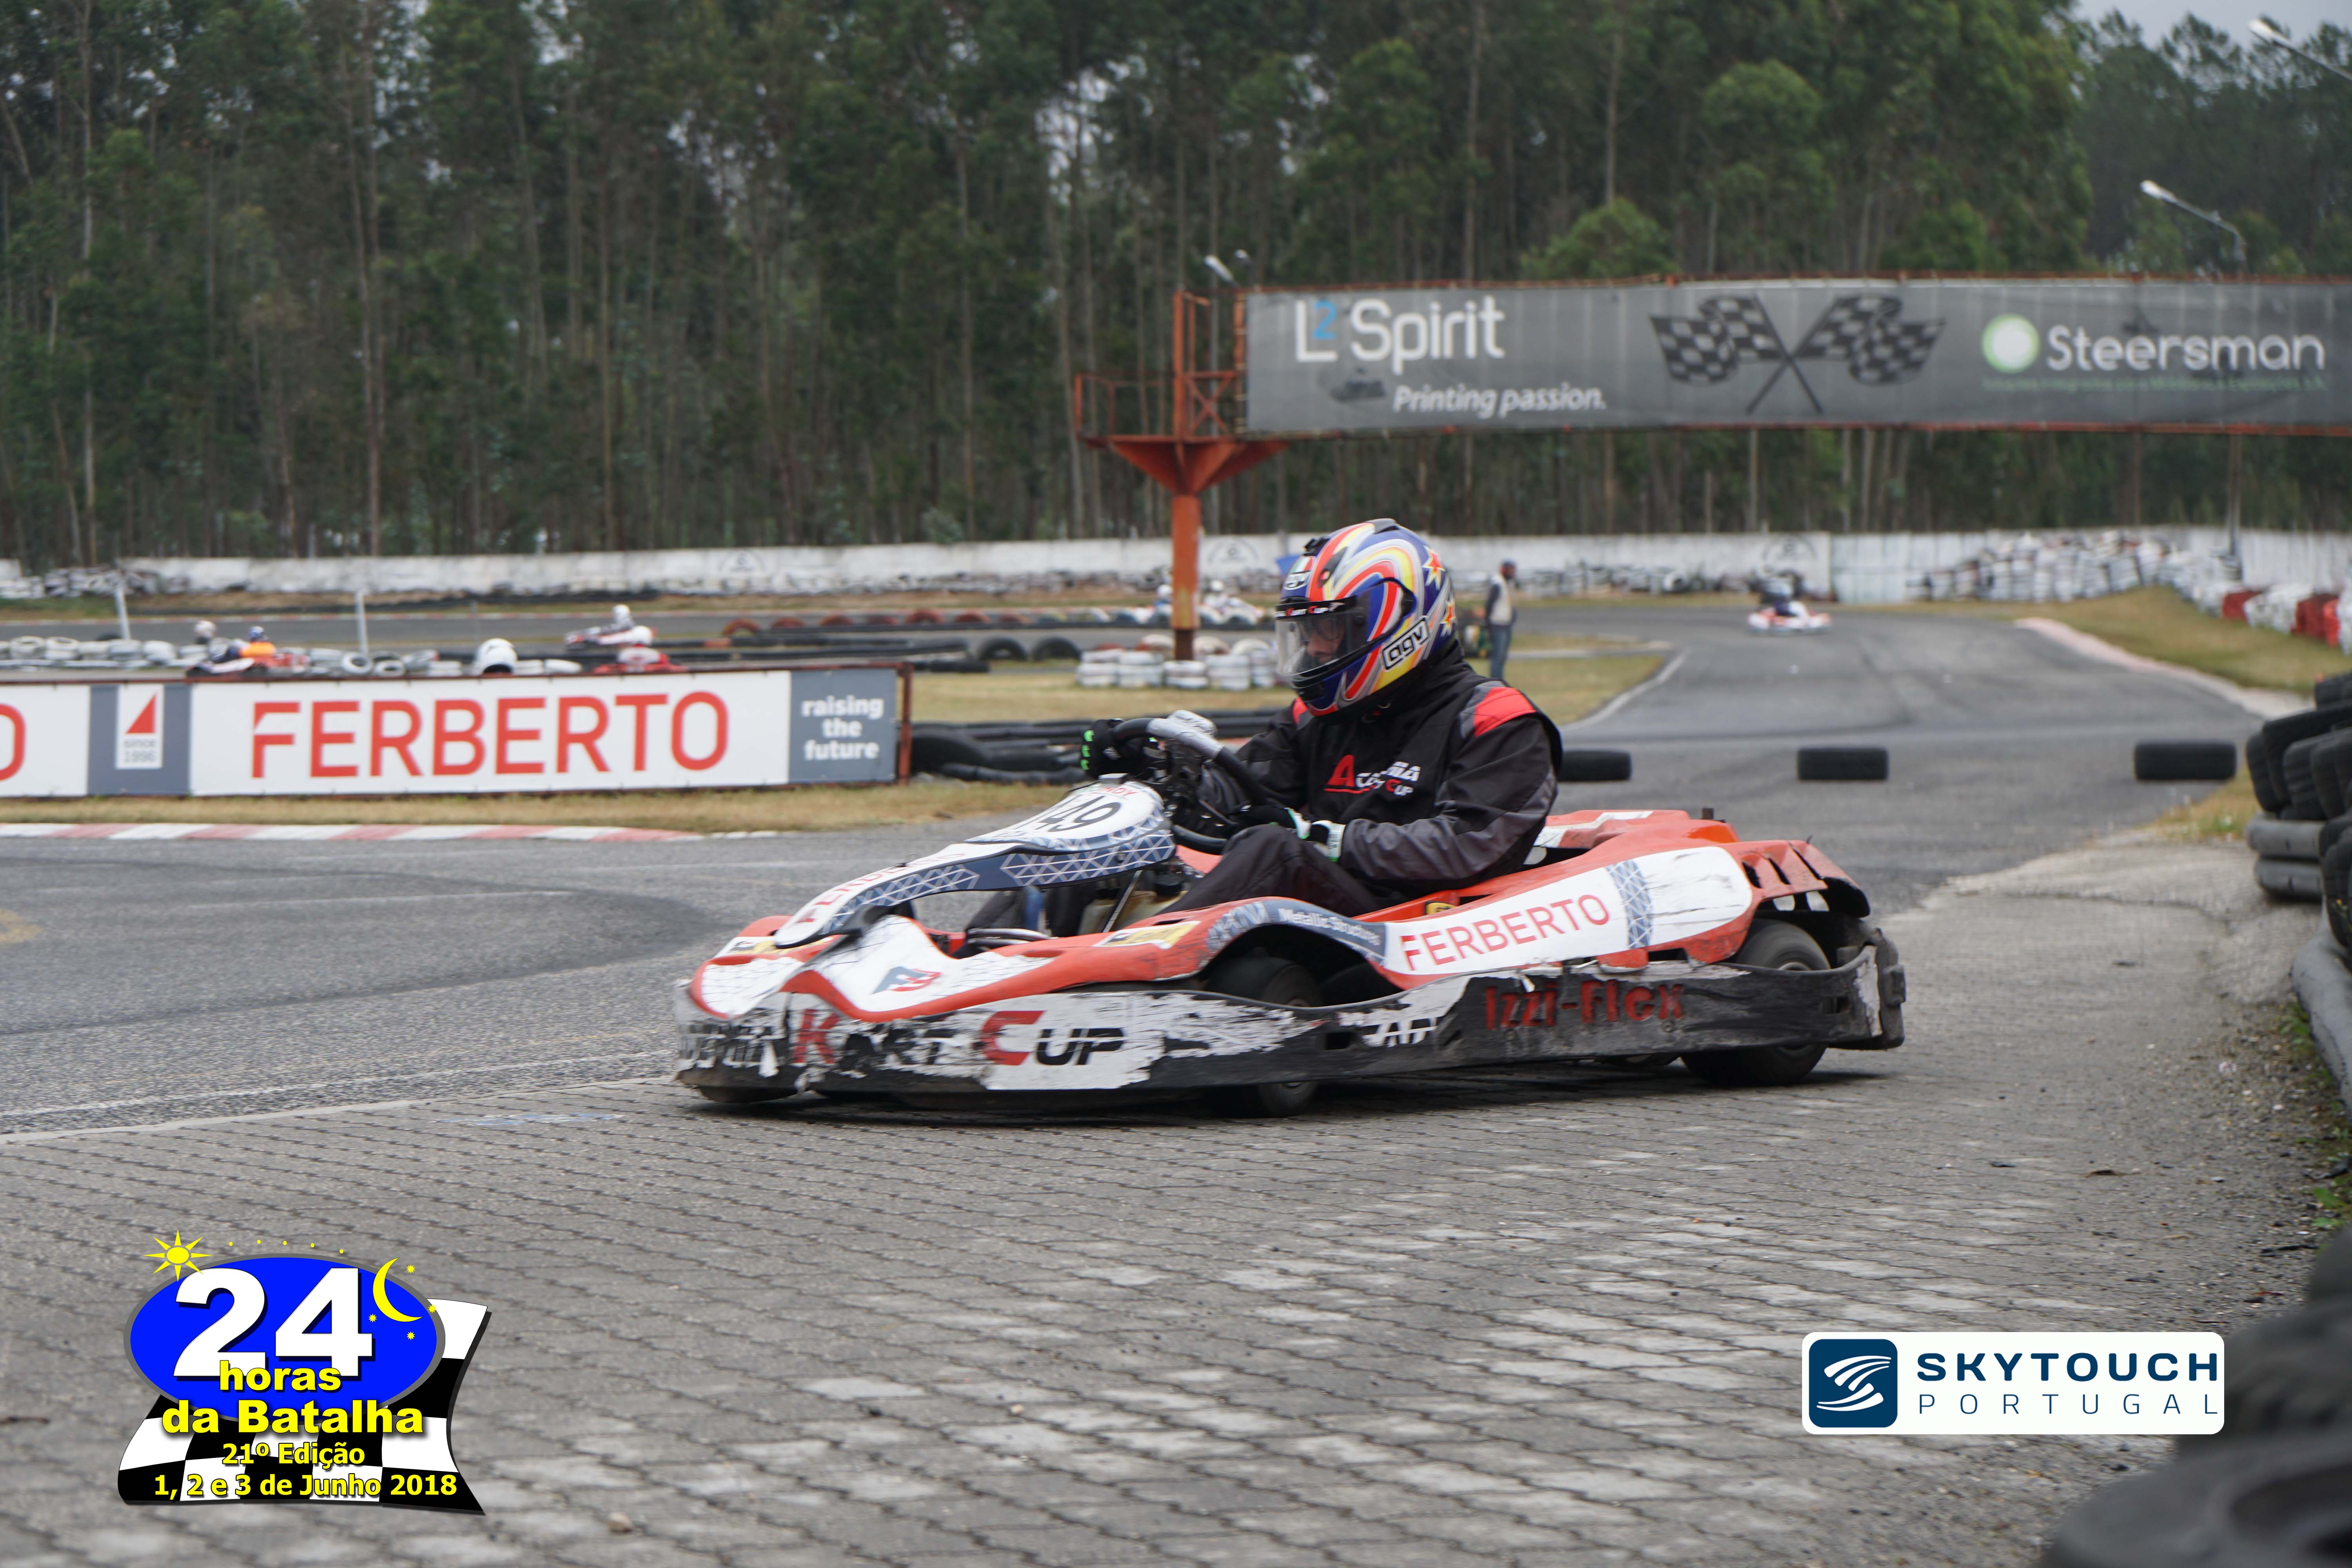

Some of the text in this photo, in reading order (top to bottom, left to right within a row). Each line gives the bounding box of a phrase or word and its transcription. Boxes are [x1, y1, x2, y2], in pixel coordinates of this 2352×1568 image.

[1351, 295, 1505, 375] Spirit
[2047, 325, 2325, 371] Steersman
[1393, 381, 1606, 419] Printing passion.
[802, 695, 884, 720] raising
[822, 717, 862, 738] the
[252, 691, 728, 778] FERBERTO
[804, 739, 879, 760] future
[1399, 894, 1610, 971] FERBERTO
[979, 1010, 1125, 1065] CUP
